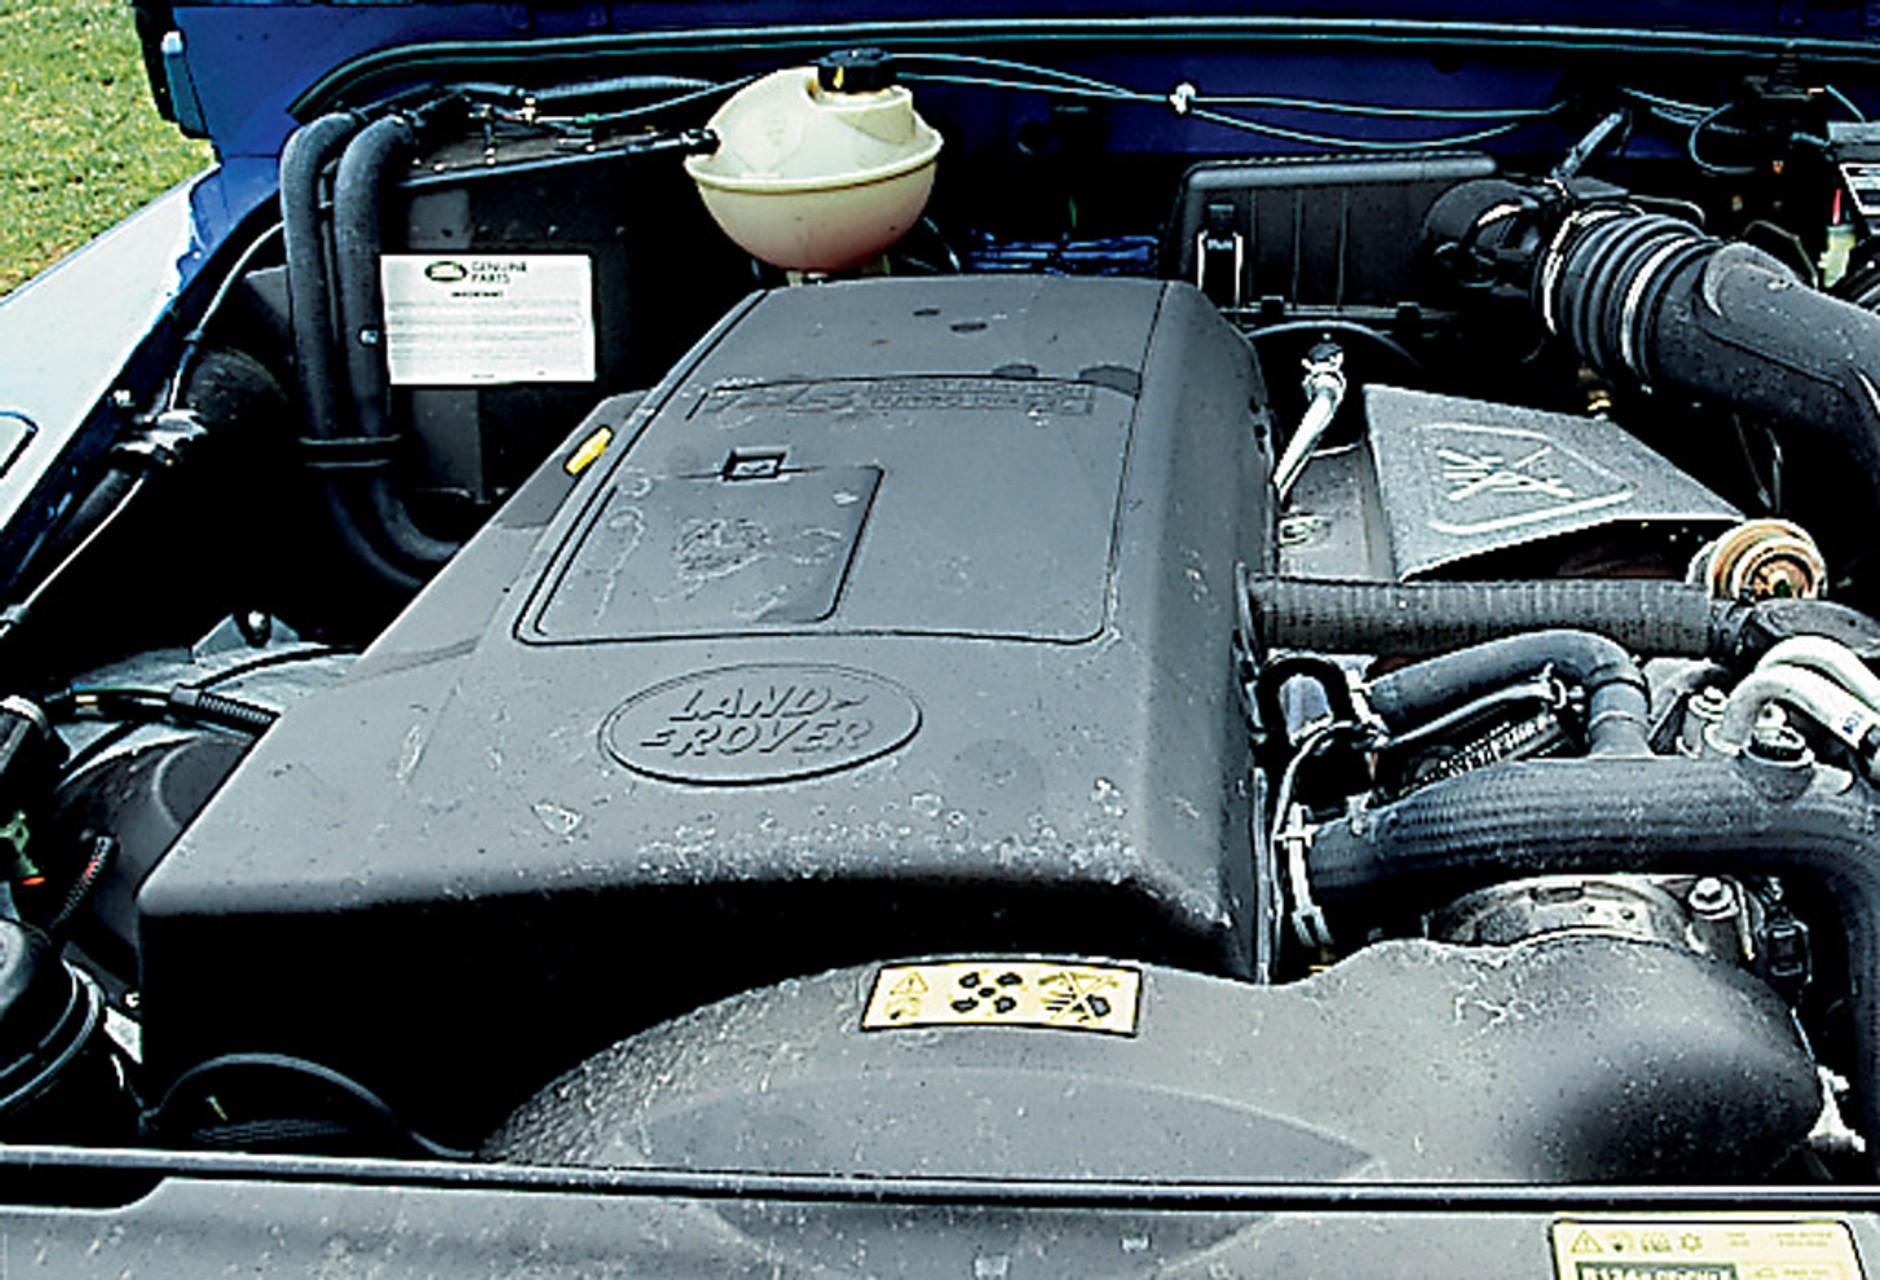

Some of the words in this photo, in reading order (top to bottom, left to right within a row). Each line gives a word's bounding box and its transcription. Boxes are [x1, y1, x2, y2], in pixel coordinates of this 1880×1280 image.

[471, 273, 511, 284] PARTS
[668, 684, 834, 722] LAND
[671, 717, 874, 758] ROVER
